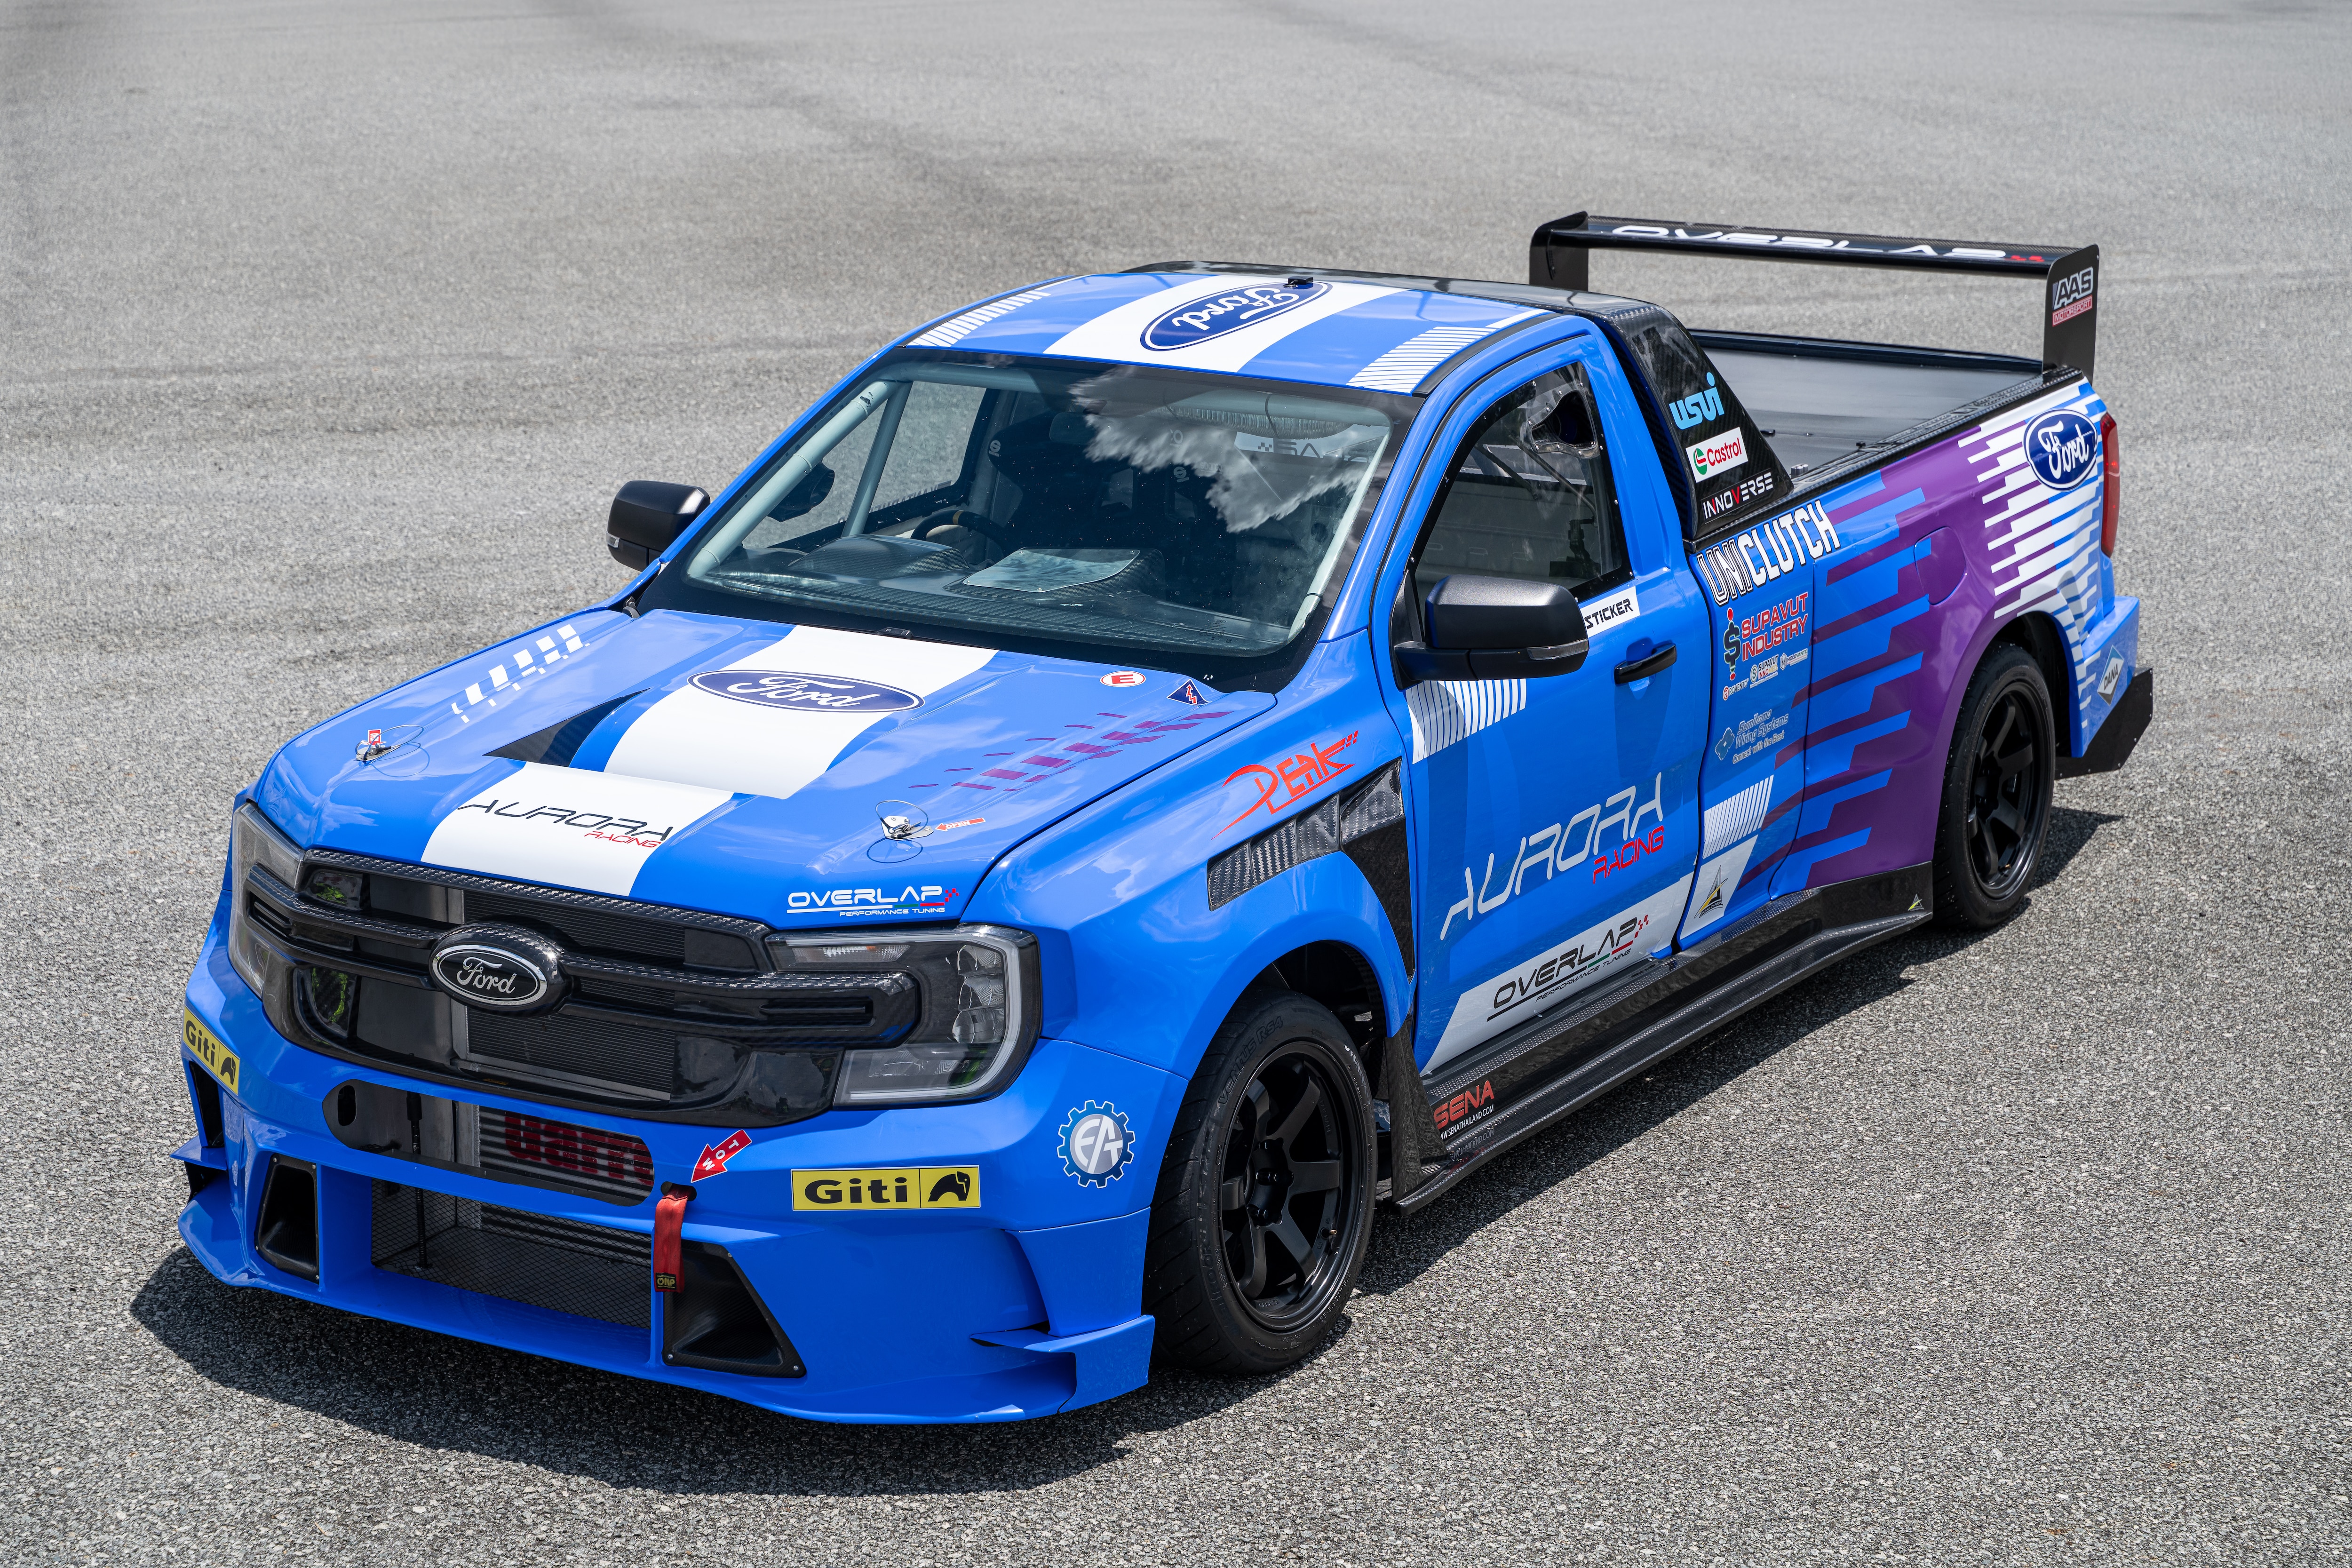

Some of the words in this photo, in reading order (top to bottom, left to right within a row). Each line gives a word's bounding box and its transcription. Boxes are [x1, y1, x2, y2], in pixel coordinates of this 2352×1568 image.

[2054, 266, 2093, 310] AAS
[1171, 287, 1300, 331] Ford
[2054, 298, 2091, 322] MOTORSPORT
[1707, 437, 1742, 467] Castrol
[2037, 420, 2089, 479] Ford
[1703, 471, 1773, 519] INNOVERSE
[1696, 499, 1841, 607] UNICLUTCH
[1584, 598, 1634, 629] STICKER
[1742, 591, 1808, 639] SUPAVUT
[1742, 613, 1809, 661] INDUSTRY
[1111, 674, 1135, 684] E
[1758, 655, 1779, 671] SUPAVUT
[2104, 663, 2118, 691] DANA
[727, 676, 882, 707] Ford
[1729, 680, 1748, 695] ROVENTO
[1736, 729, 1757, 749] Wiring
[1757, 713, 1789, 738] Systems
[1737, 709, 1772, 735] Sumitomo
[1732, 746, 1752, 764] Connect
[1752, 740, 1764, 754] with
[1772, 730, 1785, 744] Best
[457, 799, 674, 842] AURORA
[945, 820, 971, 829] OPEN
[583, 830, 662, 848] RACING
[1440, 772, 1663, 940] AURORA
[1593, 825, 1665, 884] RACING
[787, 885, 943, 907] OVERLAP
[839, 908, 909, 917] PERFORMANCE
[456, 956, 517, 994] Ford
[1493, 916, 1638, 1009] OVERLAP
[1535, 963, 1600, 1003] PERFORMANCE
[1602, 948, 1631, 967] TUNING
[185, 1020, 216, 1067] Giti
[1433, 1080, 1495, 1130] SENA
[702, 1138, 740, 1171] TOW
[804, 1177, 908, 1204] Giti
[657, 1277, 676, 1287] OMP
